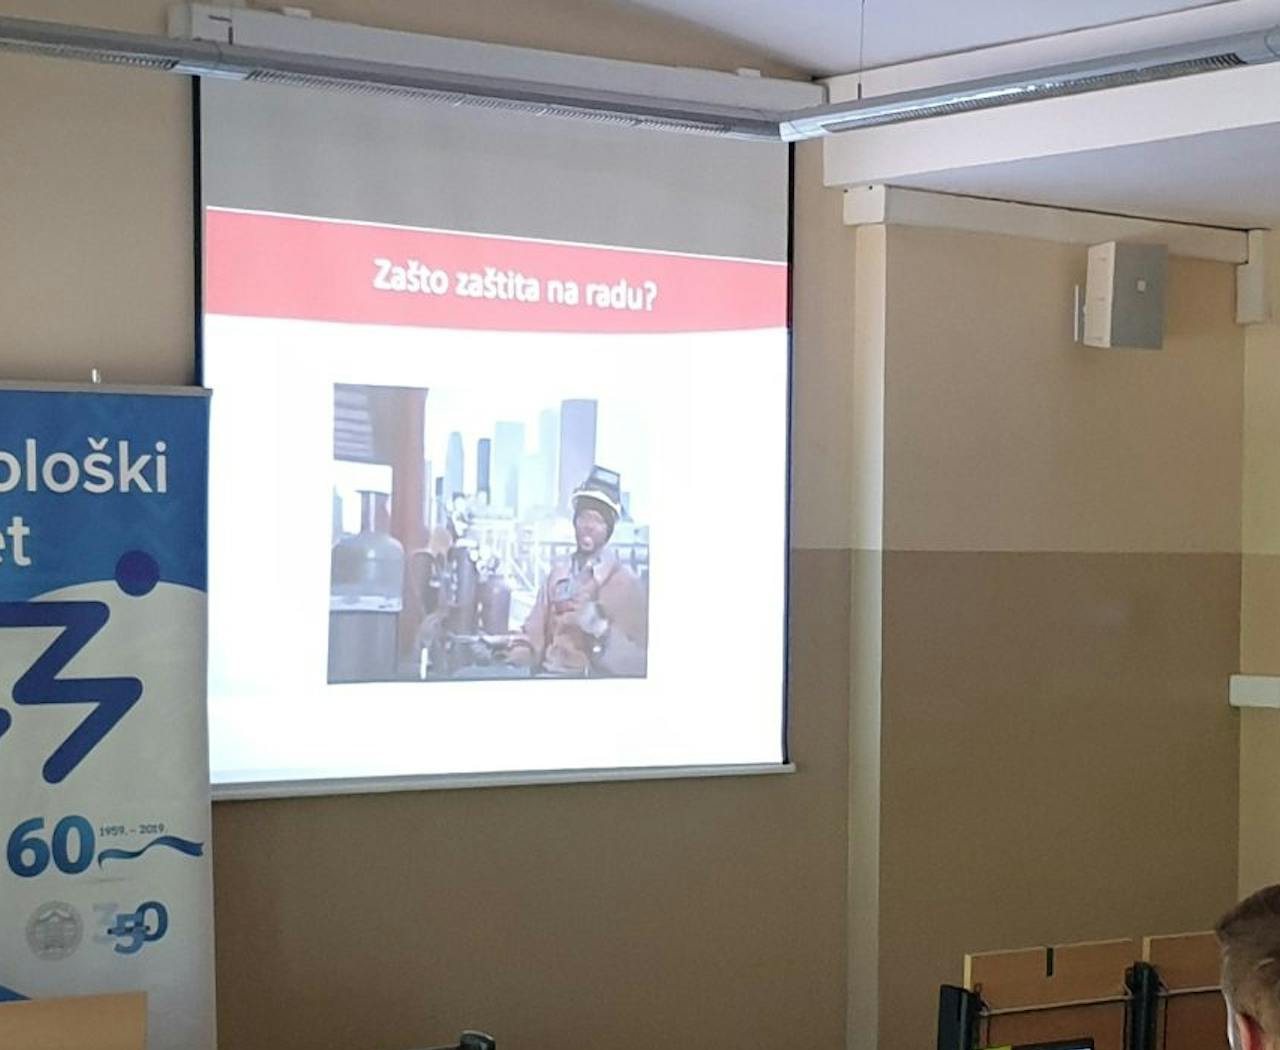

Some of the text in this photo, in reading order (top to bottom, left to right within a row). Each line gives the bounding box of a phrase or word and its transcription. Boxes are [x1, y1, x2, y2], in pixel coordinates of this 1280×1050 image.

[373, 258, 657, 311] Zašto zaštita na radu?
[6, 815, 96, 877] 60
